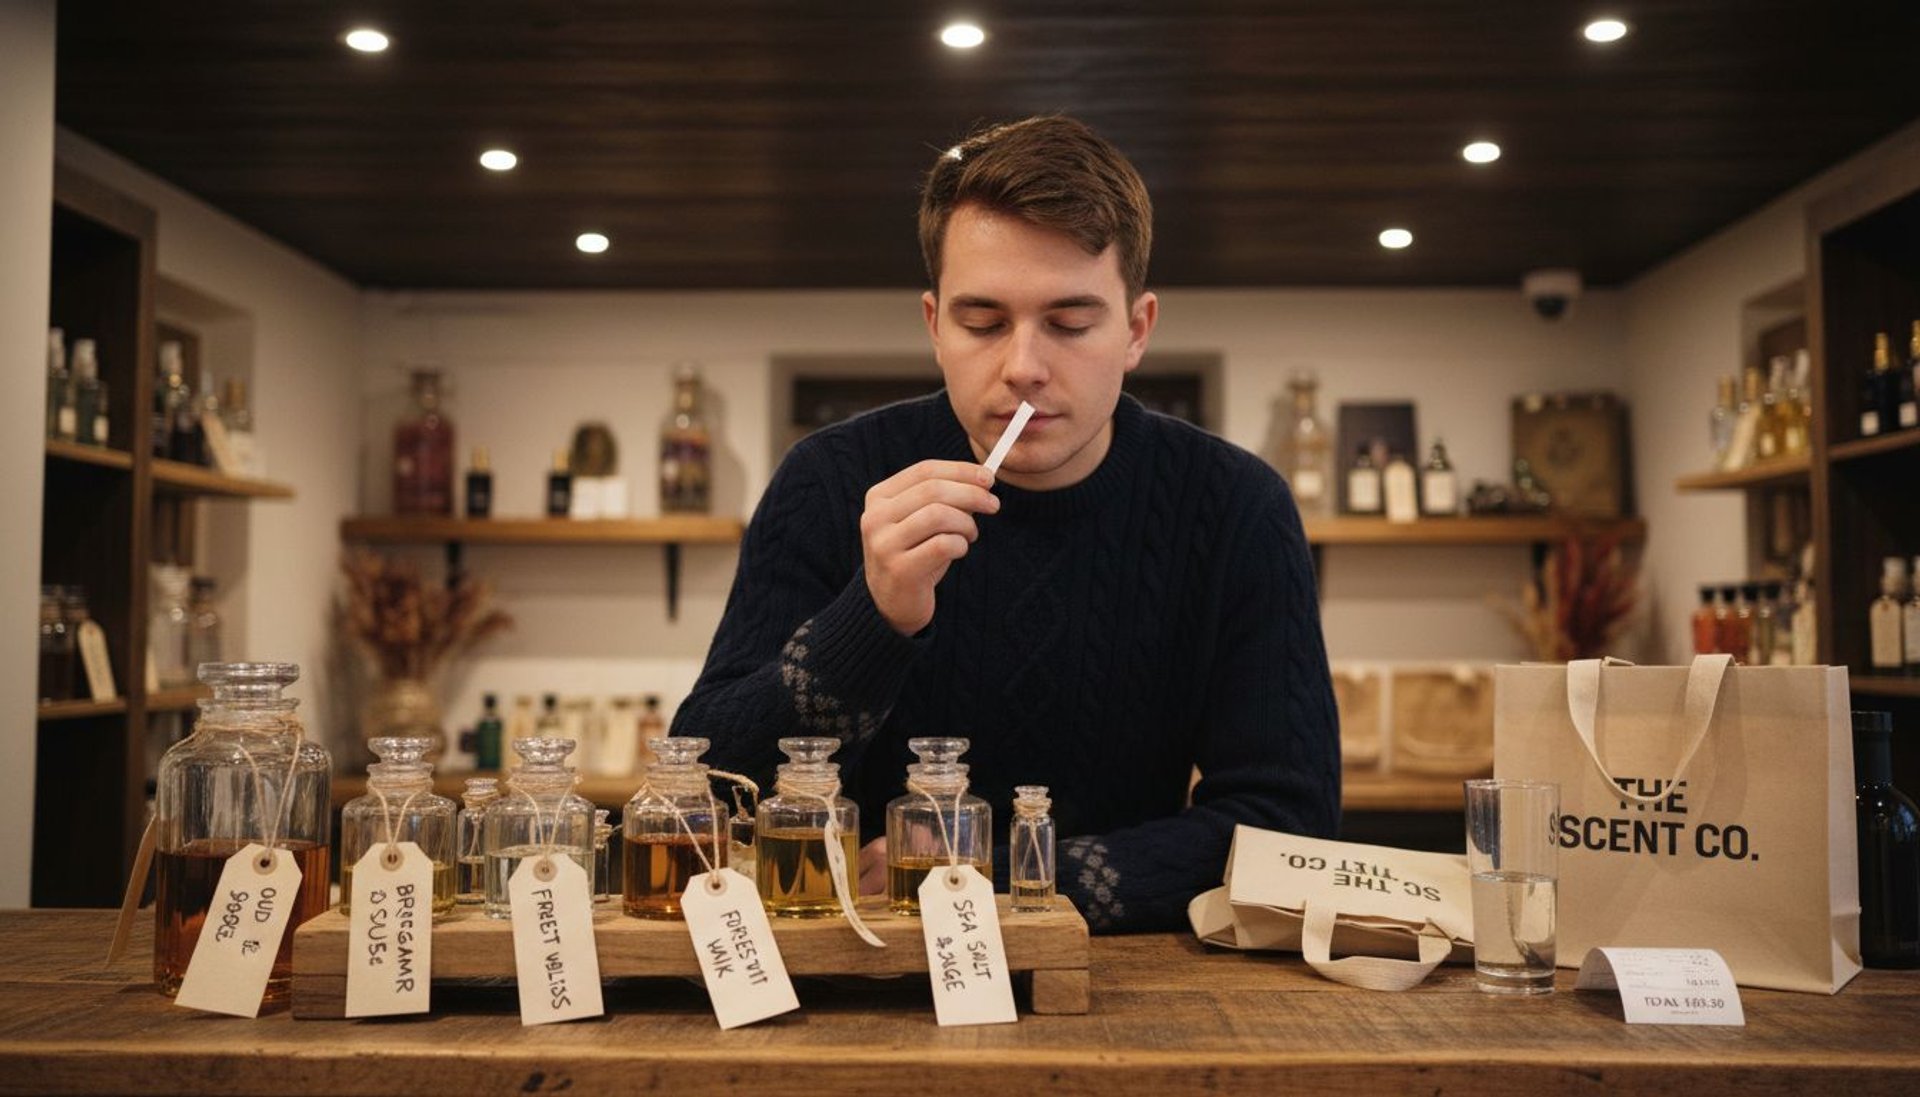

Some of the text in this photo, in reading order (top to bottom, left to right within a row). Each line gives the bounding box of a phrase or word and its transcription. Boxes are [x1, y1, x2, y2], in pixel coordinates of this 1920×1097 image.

[1613, 777, 1688, 814] THE
[1559, 814, 1685, 856] SCENT
[1695, 823, 1759, 861] CO.
[1280, 852, 1327, 871] CO.
[254, 887, 277, 923] OUD
